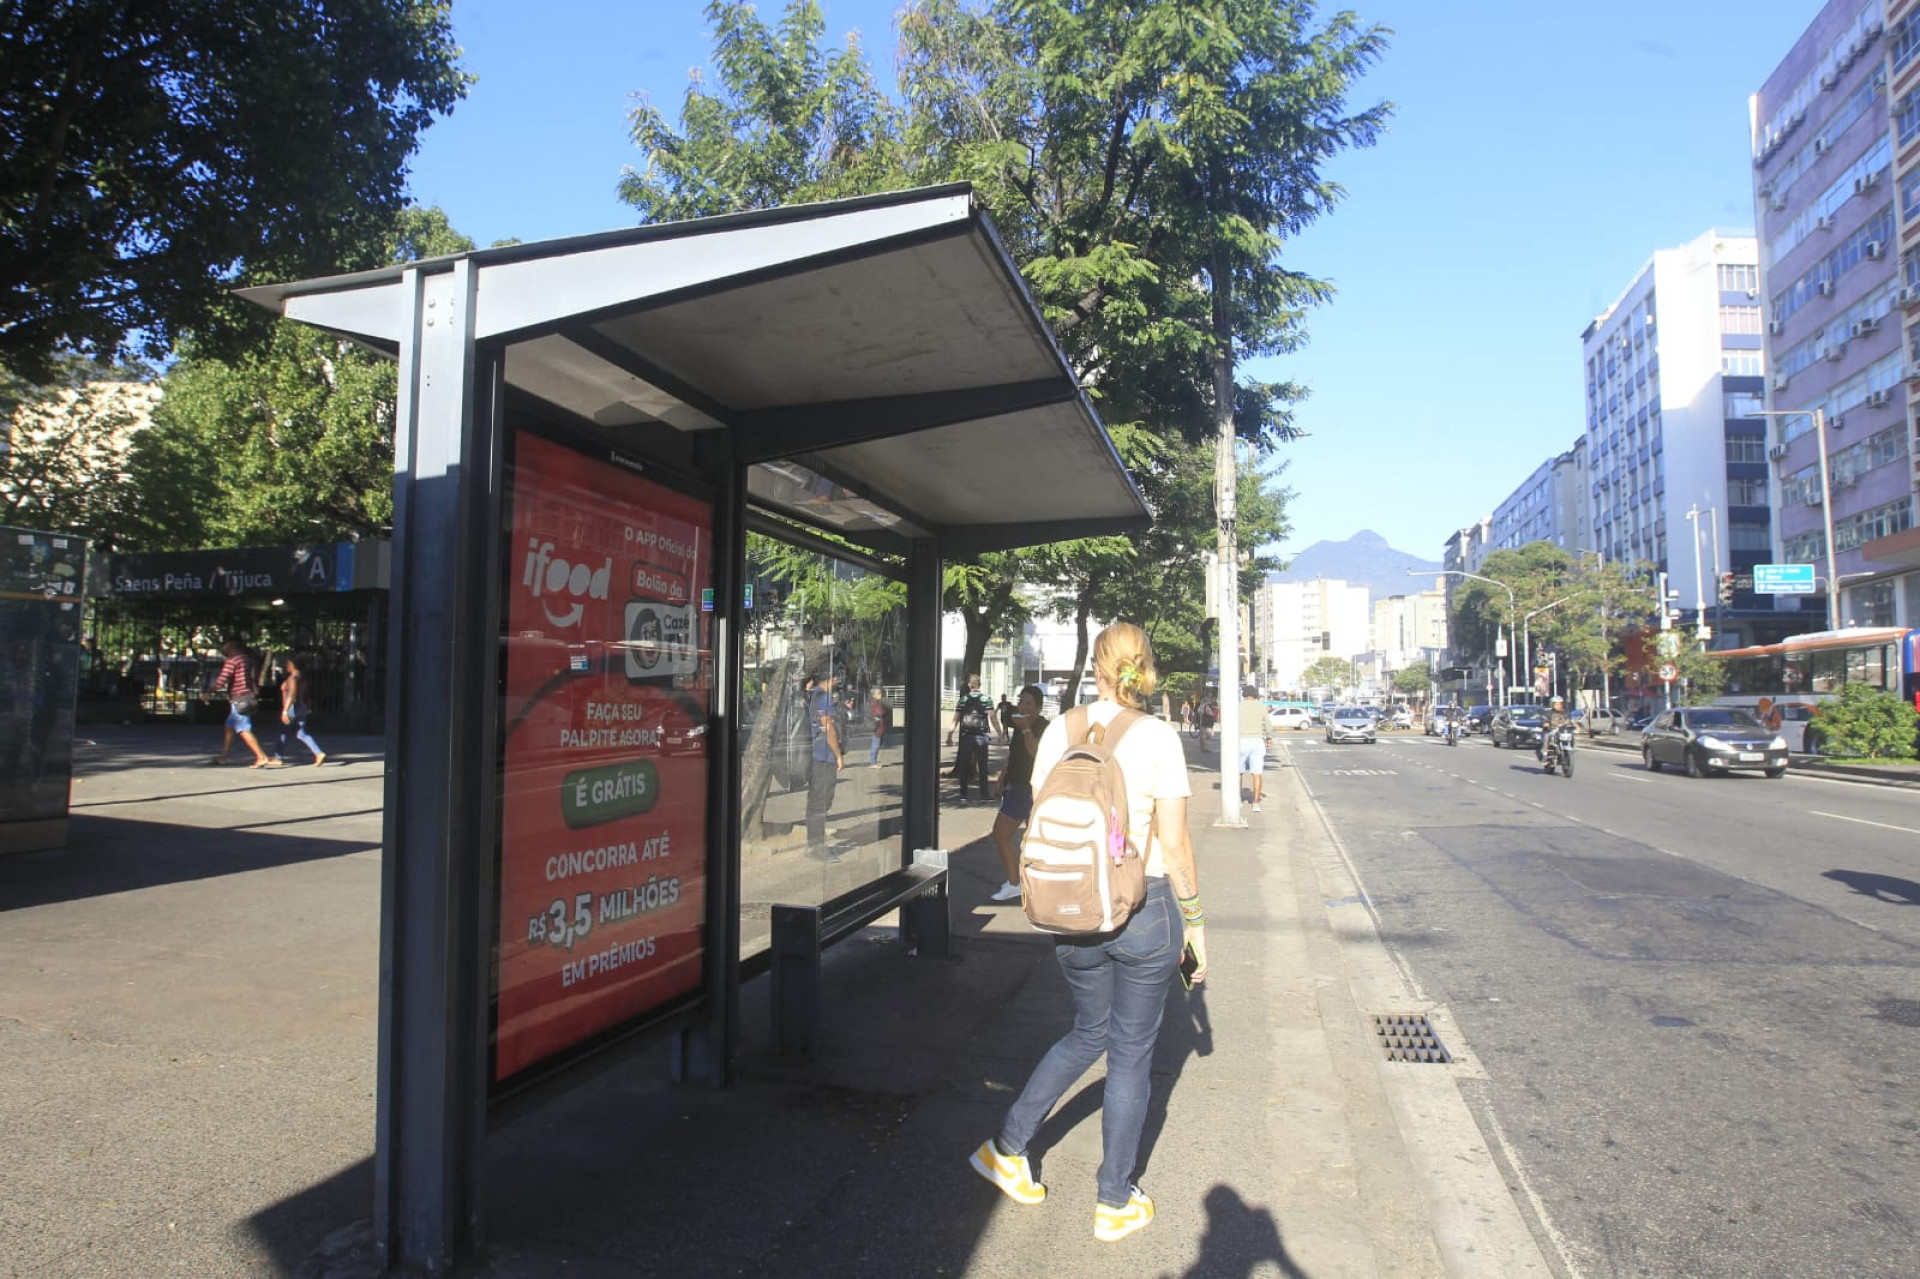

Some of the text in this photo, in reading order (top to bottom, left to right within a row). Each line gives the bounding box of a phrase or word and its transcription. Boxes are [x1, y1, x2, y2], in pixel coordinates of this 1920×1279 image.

[636, 529, 657, 548] APP
[658, 535, 686, 558] Oficial
[115, 575, 160, 593] Saens
[164, 571, 202, 590] Peña
[223, 570, 272, 594] Tijuca
[308, 556, 326, 581] A
[522, 537, 613, 601] ifood
[636, 568, 683, 599] Bolão da
[664, 613, 690, 630] Cazé
[587, 702, 642, 726] FAÇA SEU
[560, 729, 617, 748] PALPITE
[575, 770, 646, 806] É GRÁTIS
[545, 830, 671, 881] CONCORRA ATÉ
[528, 876, 680, 948] R$ 3,5 MILHÕES
[562, 936, 656, 987] EM PRÊMIOS
